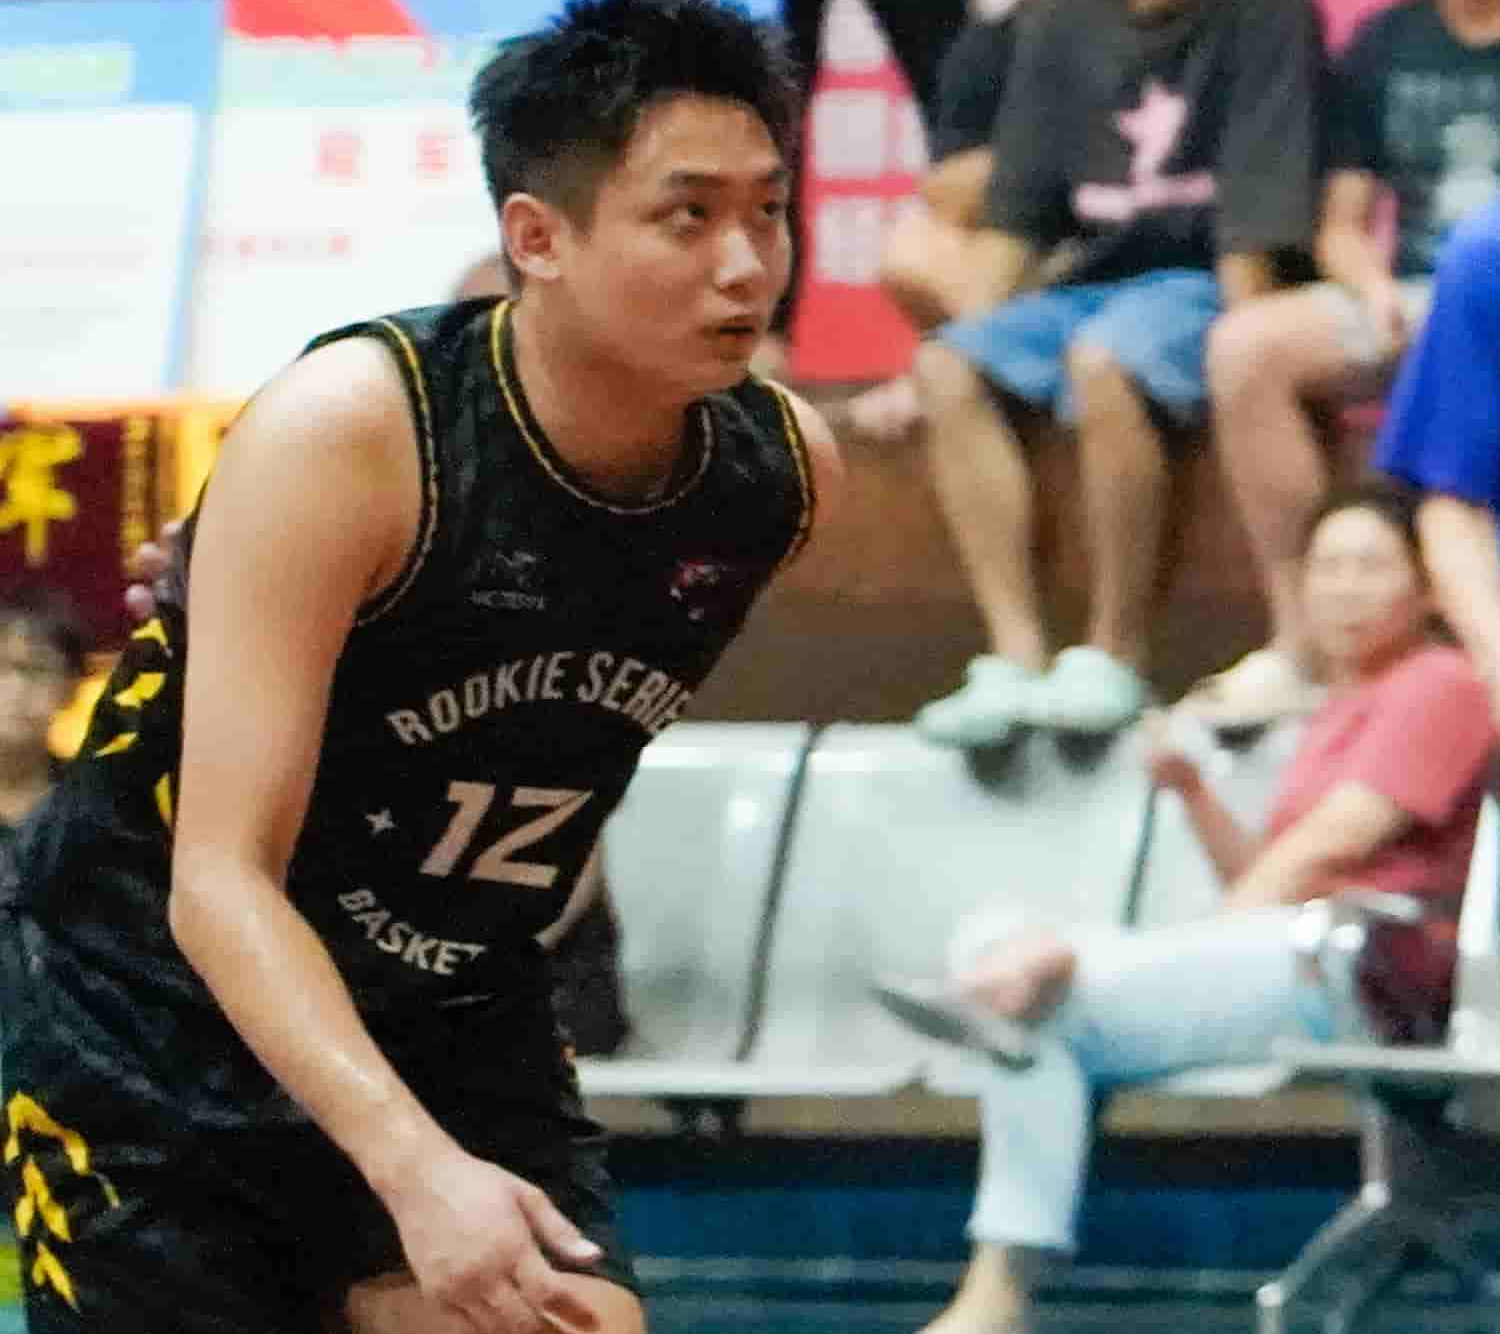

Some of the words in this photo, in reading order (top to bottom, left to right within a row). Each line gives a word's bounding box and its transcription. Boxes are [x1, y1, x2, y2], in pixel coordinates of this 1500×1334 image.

[386, 650, 576, 747] ROOKIE
[577, 650, 696, 733] SERIE
[418, 779, 595, 890] 12
